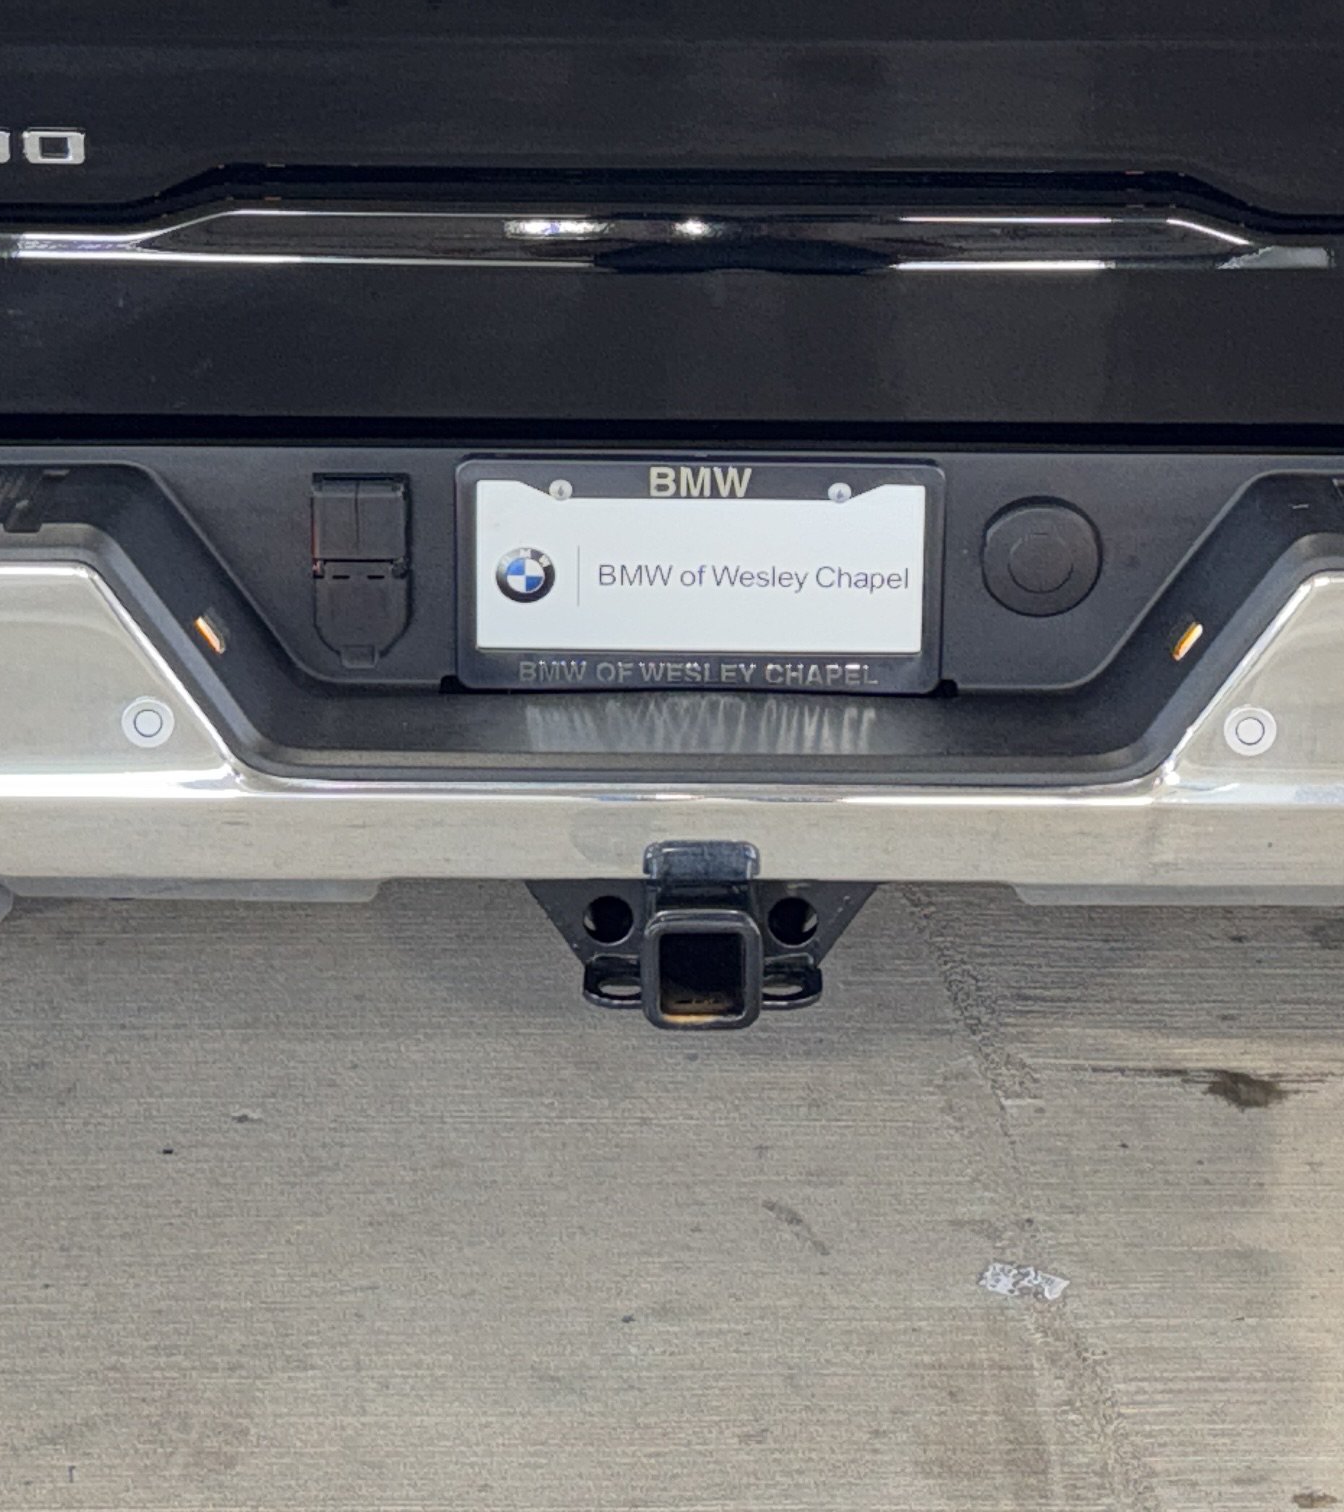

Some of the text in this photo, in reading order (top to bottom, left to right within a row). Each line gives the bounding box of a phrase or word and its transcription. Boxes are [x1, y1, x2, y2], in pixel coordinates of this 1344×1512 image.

[649, 465, 752, 498] BMW
[598, 564, 909, 594] BMW of Wesley Chapel
[519, 660, 879, 686] BMW OF WESLEY CHAPEL
